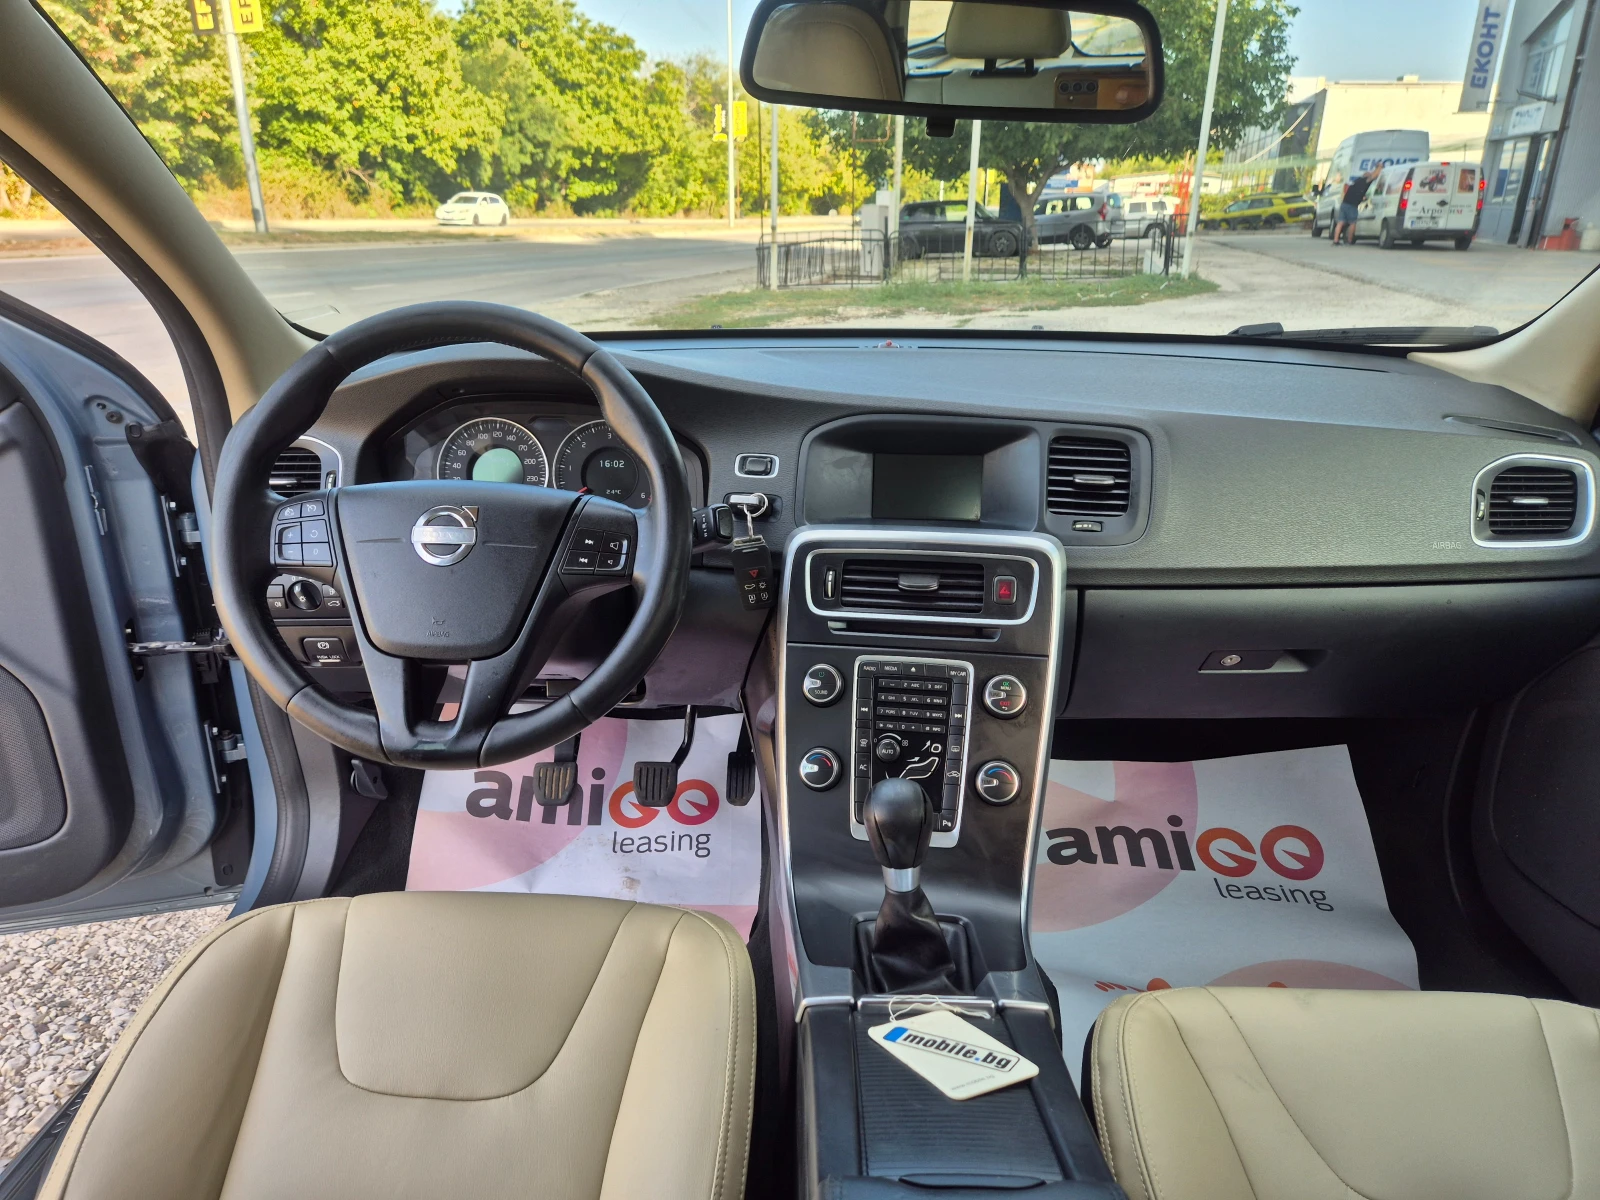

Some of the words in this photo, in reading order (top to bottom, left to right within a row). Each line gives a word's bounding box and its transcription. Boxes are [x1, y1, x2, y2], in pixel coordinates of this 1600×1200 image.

[1470, 6, 1501, 89] ЕКОНТ
[600, 460, 625, 468] 16:02
[1432, 541, 1462, 550] AIRBAG
[612, 831, 712, 858] leasing
[1214, 878, 1334, 912] leasing
[902, 1032, 1012, 1069] mobile.bg
